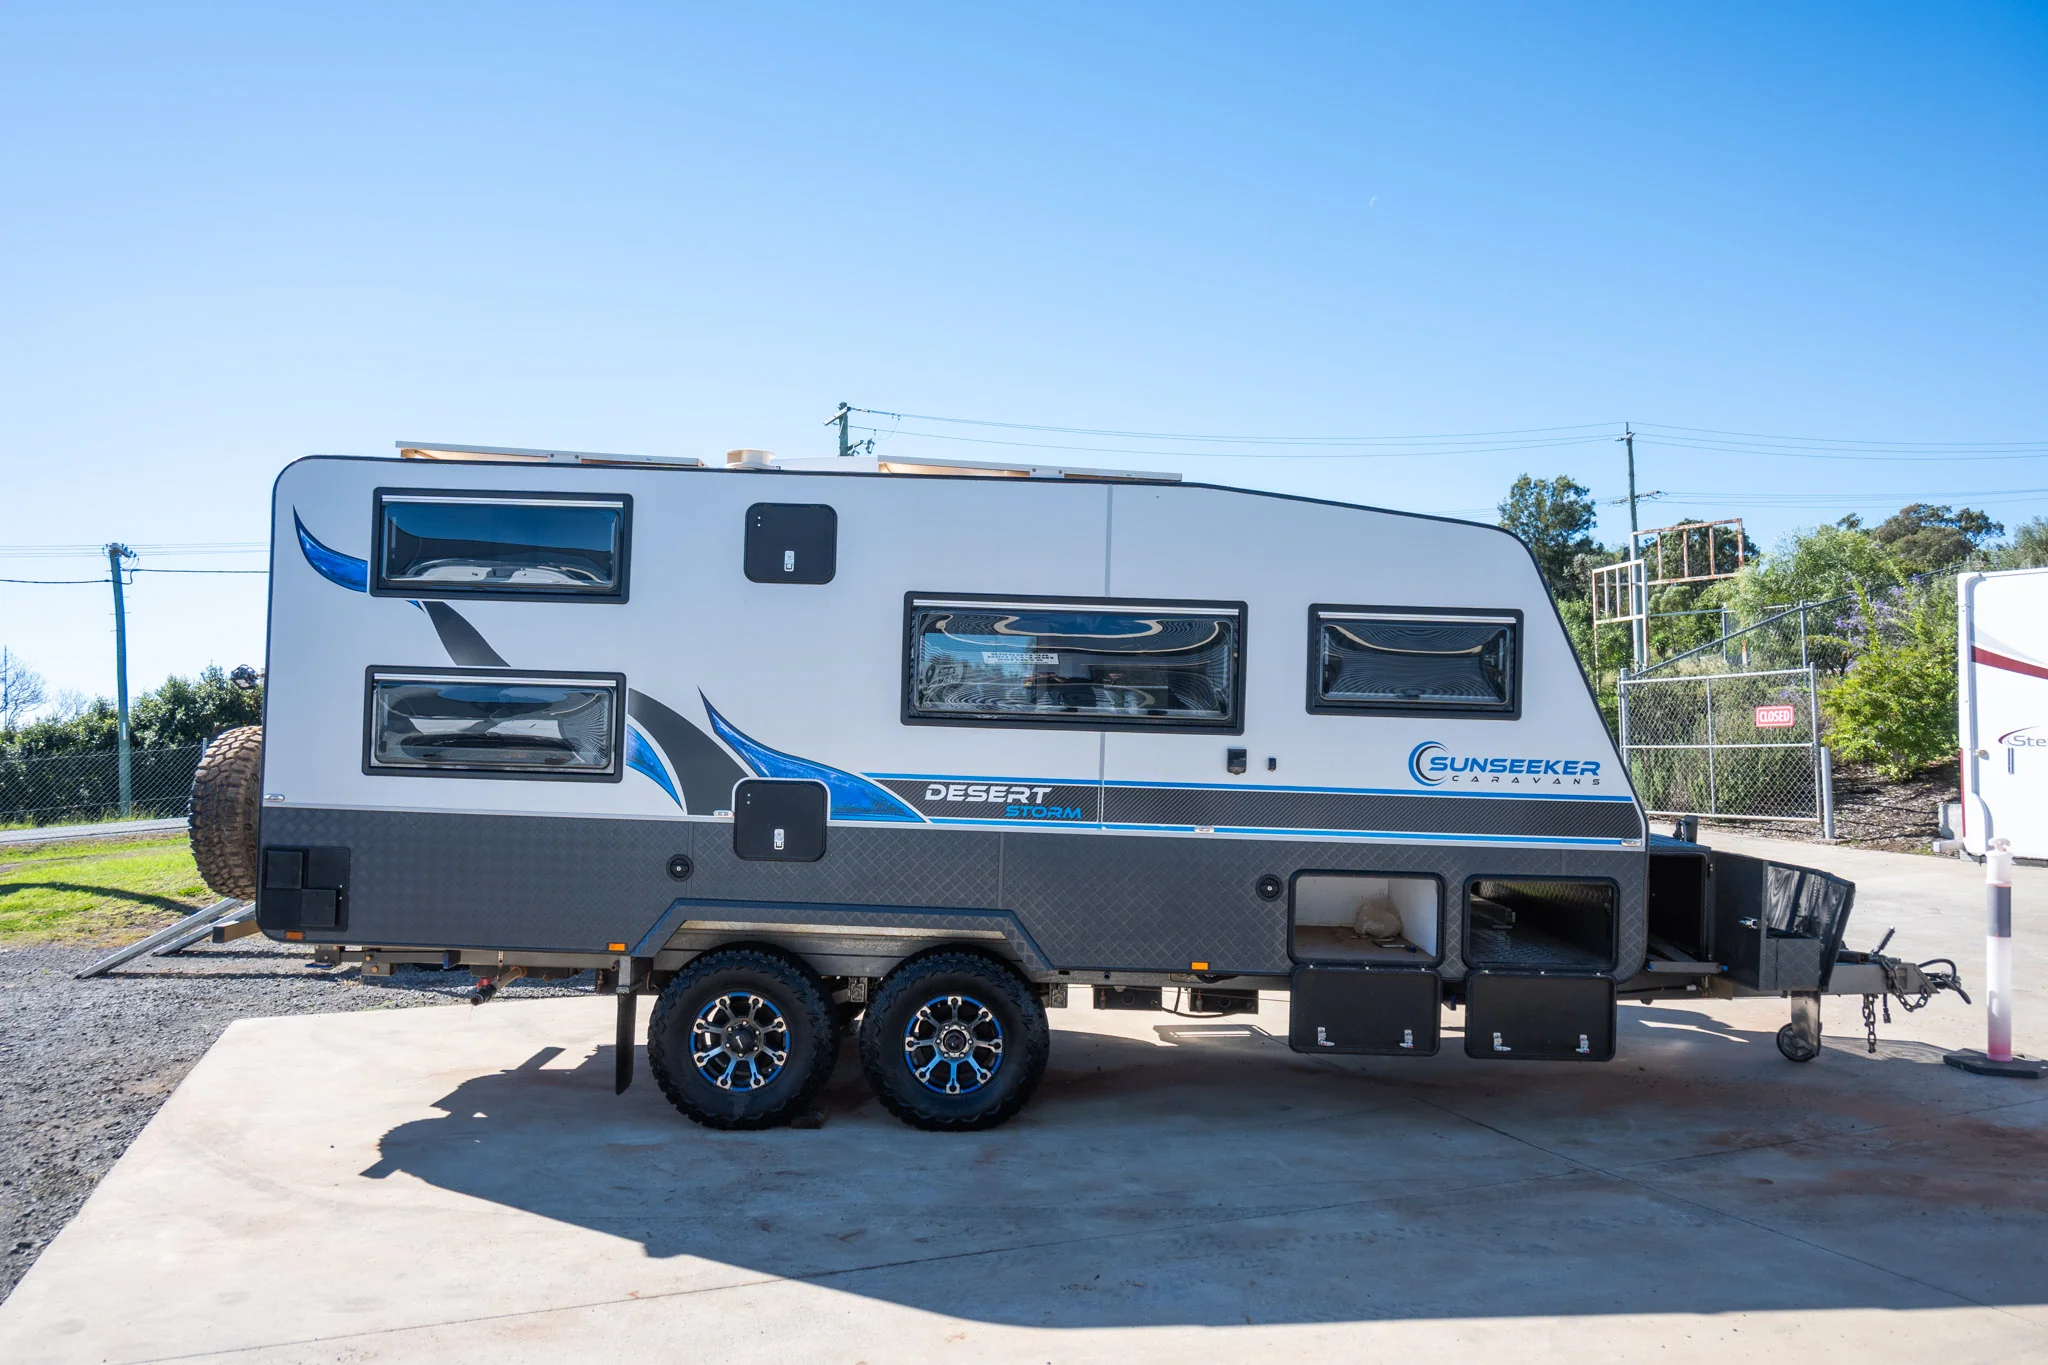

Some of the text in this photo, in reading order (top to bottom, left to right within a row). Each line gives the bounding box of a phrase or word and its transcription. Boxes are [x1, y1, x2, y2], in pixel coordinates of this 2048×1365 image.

[1760, 710, 1790, 723] CLOSED
[1429, 756, 1601, 776] SUNSEEKER
[1452, 775, 1601, 786] CARAVANS
[925, 784, 1052, 804] DESERT
[1005, 805, 1082, 819] STORM
